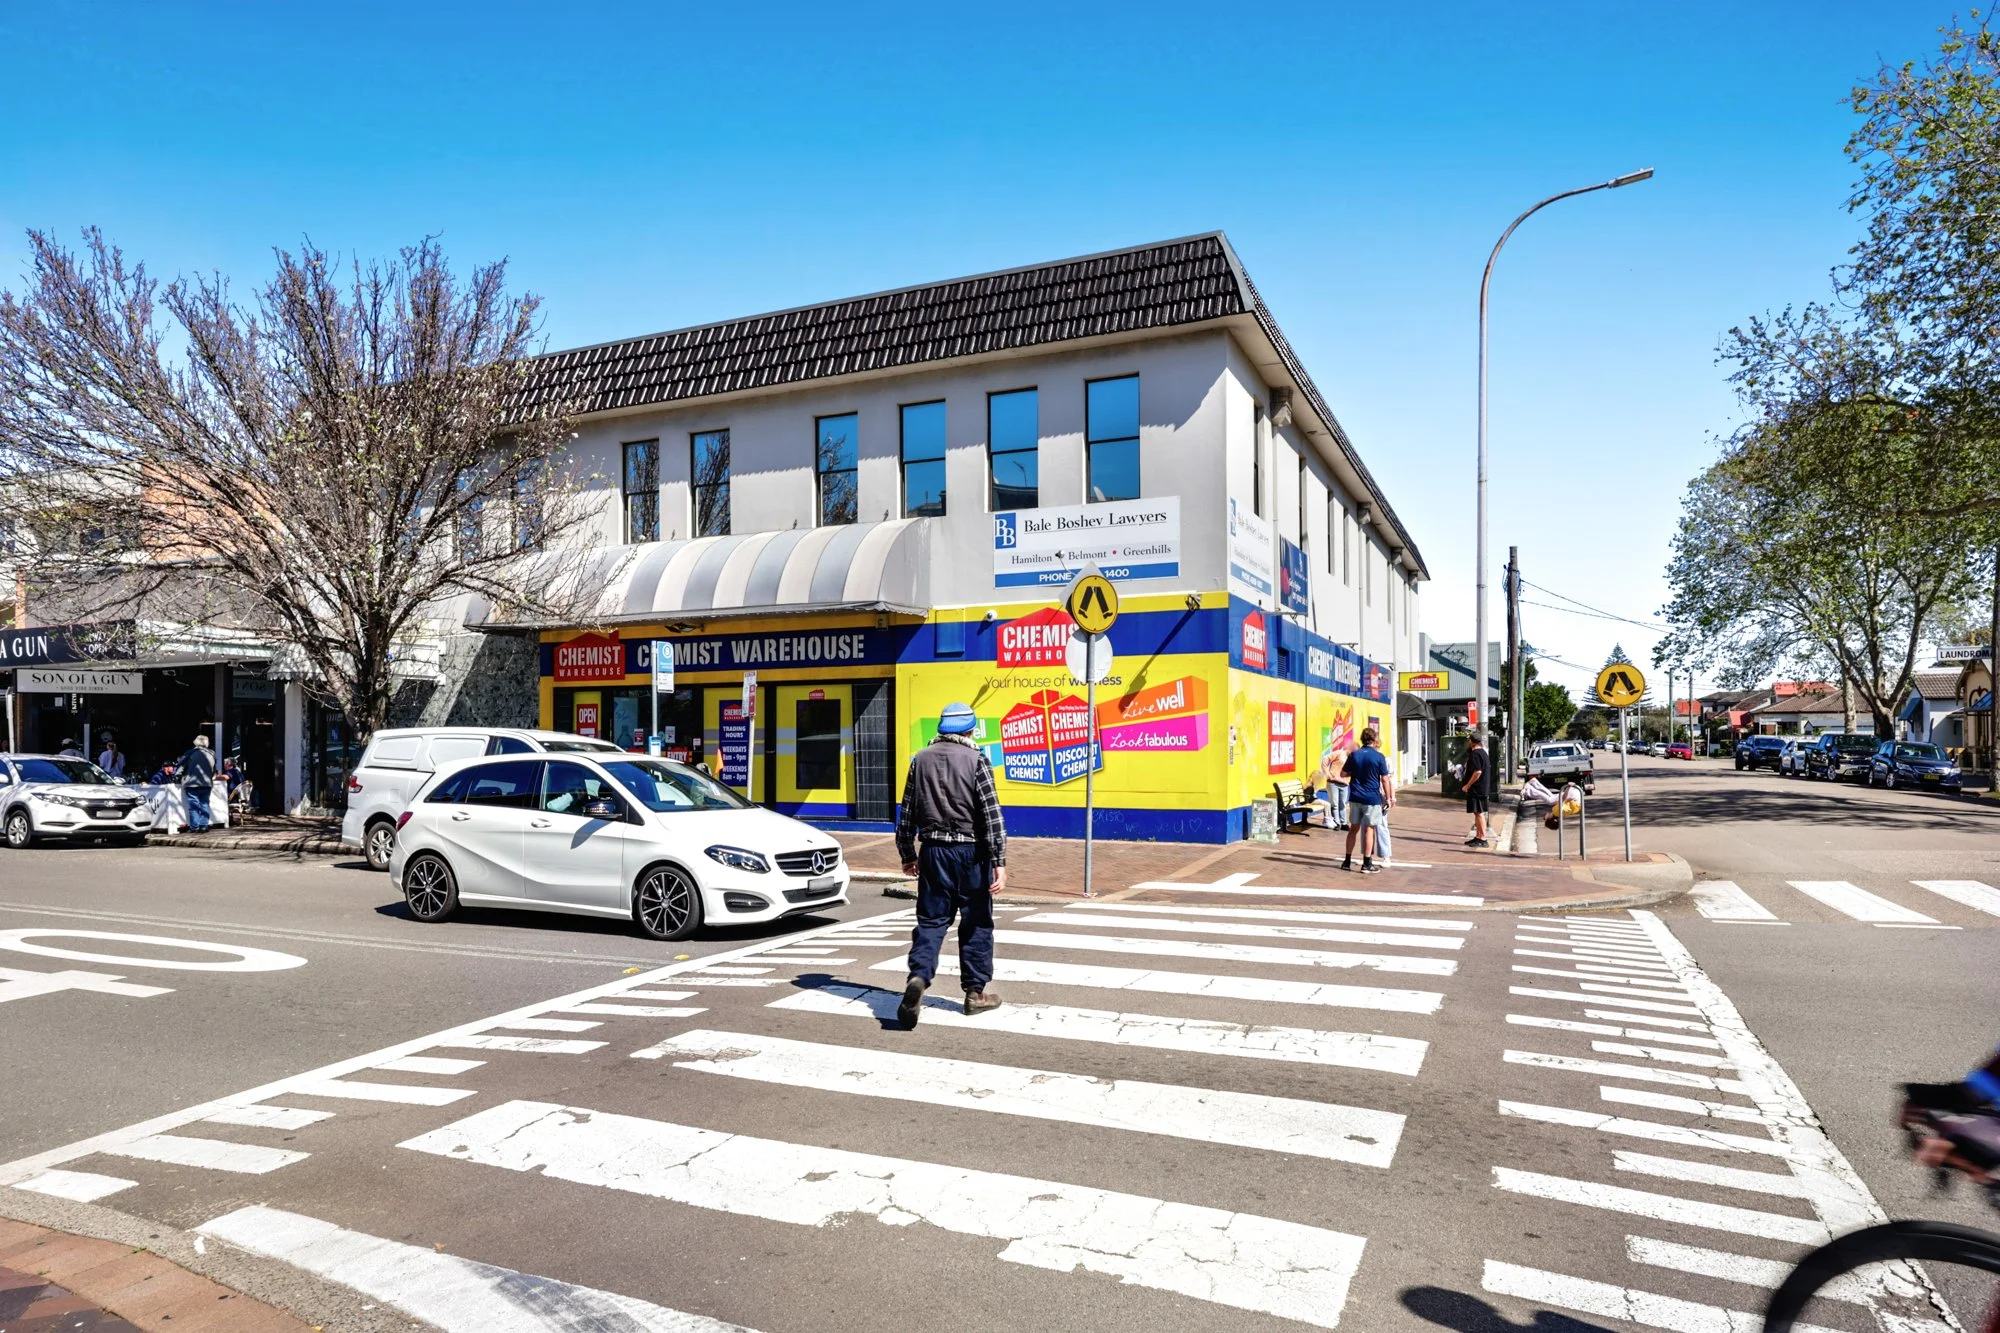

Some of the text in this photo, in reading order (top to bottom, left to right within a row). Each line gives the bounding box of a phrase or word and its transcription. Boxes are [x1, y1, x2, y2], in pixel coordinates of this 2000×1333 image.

[1024, 510, 1167, 532] Bale Boshev Lawyers
[1011, 544, 1171, 565] Hamilton Belmont Greenhills
[1039, 568, 1130, 582] PHONE 1400
[1003, 623, 1080, 649] CHEMIS
[1244, 623, 1266, 651] CHEMIST
[12, 635, 48, 658] GUN
[637, 634, 865, 668] CMIST WAREHOUSE
[559, 645, 620, 667] CHEMIST
[1004, 650, 1063, 662] WAREHO
[1940, 650, 1992, 659] LAUNDROM
[559, 667, 621, 677] WAREHOUSE
[32, 673, 130, 686] SON OF A GUN
[984, 675, 1010, 689] Your
[1013, 675, 1051, 689] house
[1054, 674, 1067, 687] of
[1410, 677, 1438, 685] CHEMIST
[1123, 680, 1185, 719] Live well
[579, 708, 597, 724] OPEN
[1051, 711, 1089, 731] CHEMIS
[973, 718, 987, 739] ell
[1002, 715, 1044, 739] CHEMIST
[1003, 734, 1045, 748] WAREHOUSE
[1053, 728, 1090, 742] WAREHOU
[1110, 731, 1188, 748] Look fabulous
[667, 751, 688, 761] ENTRY
[722, 745, 747, 753] WEEKDAYS
[735, 754, 747, 762] 9pm
[1005, 753, 1047, 766] DISCOUNT
[722, 765, 747, 773] WEEKENDS
[1009, 767, 1045, 780] CHEMIST
[1061, 756, 1096, 778] CHEMT
[735, 773, 747, 782] 8pm
